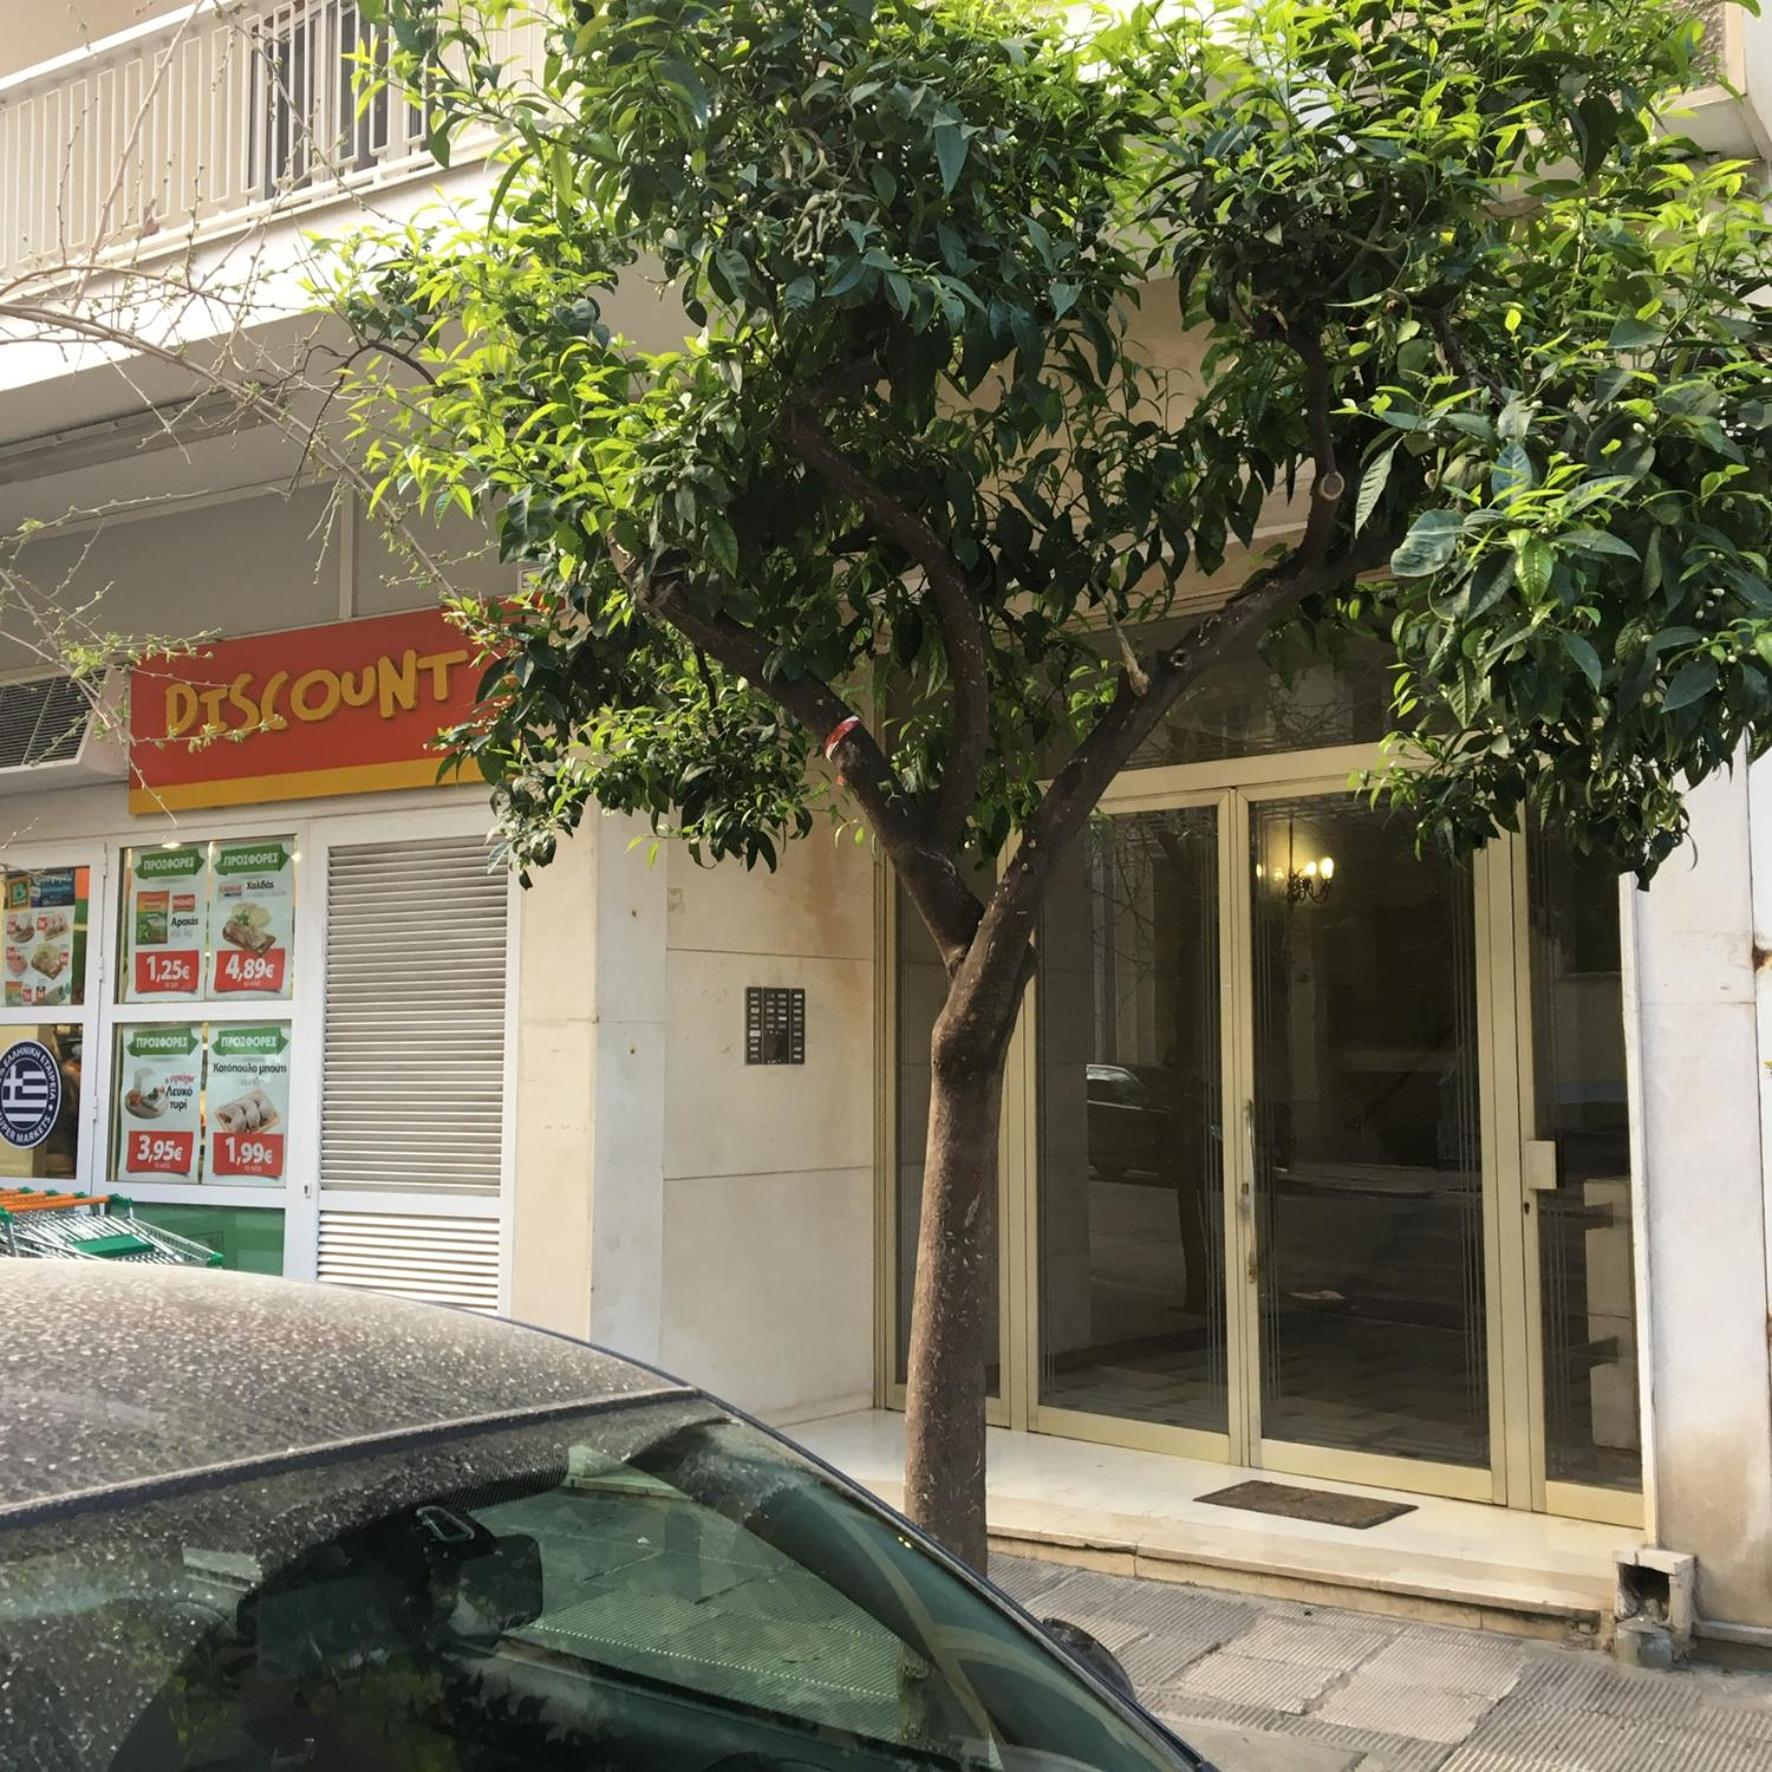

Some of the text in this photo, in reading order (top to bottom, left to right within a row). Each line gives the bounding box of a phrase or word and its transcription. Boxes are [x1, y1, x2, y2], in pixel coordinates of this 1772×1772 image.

[165, 649, 470, 738] DISCOUNT
[143, 857, 195, 870] ΠΡΟΣΦΟΡΕΣ
[223, 852, 279, 867] ΠΡΟΣΦΟΡΕΣ
[147, 955, 190, 983] 1,25€
[225, 954, 275, 982] 4,89€
[136, 1036, 188, 1049] ΠΡΟΣΦΟΡΕΣ
[220, 1035, 278, 1048] ΠΡΟΣΦΟΡΕΣ
[3, 1046, 57, 1100] ΕΛΛΗΝΙΚΗ ΕΤΑΙΡΕΙΑ
[16, 1116, 51, 1143] MARKETS
[137, 1135, 183, 1163] 3,95€
[225, 1137, 273, 1166] 1,99€
